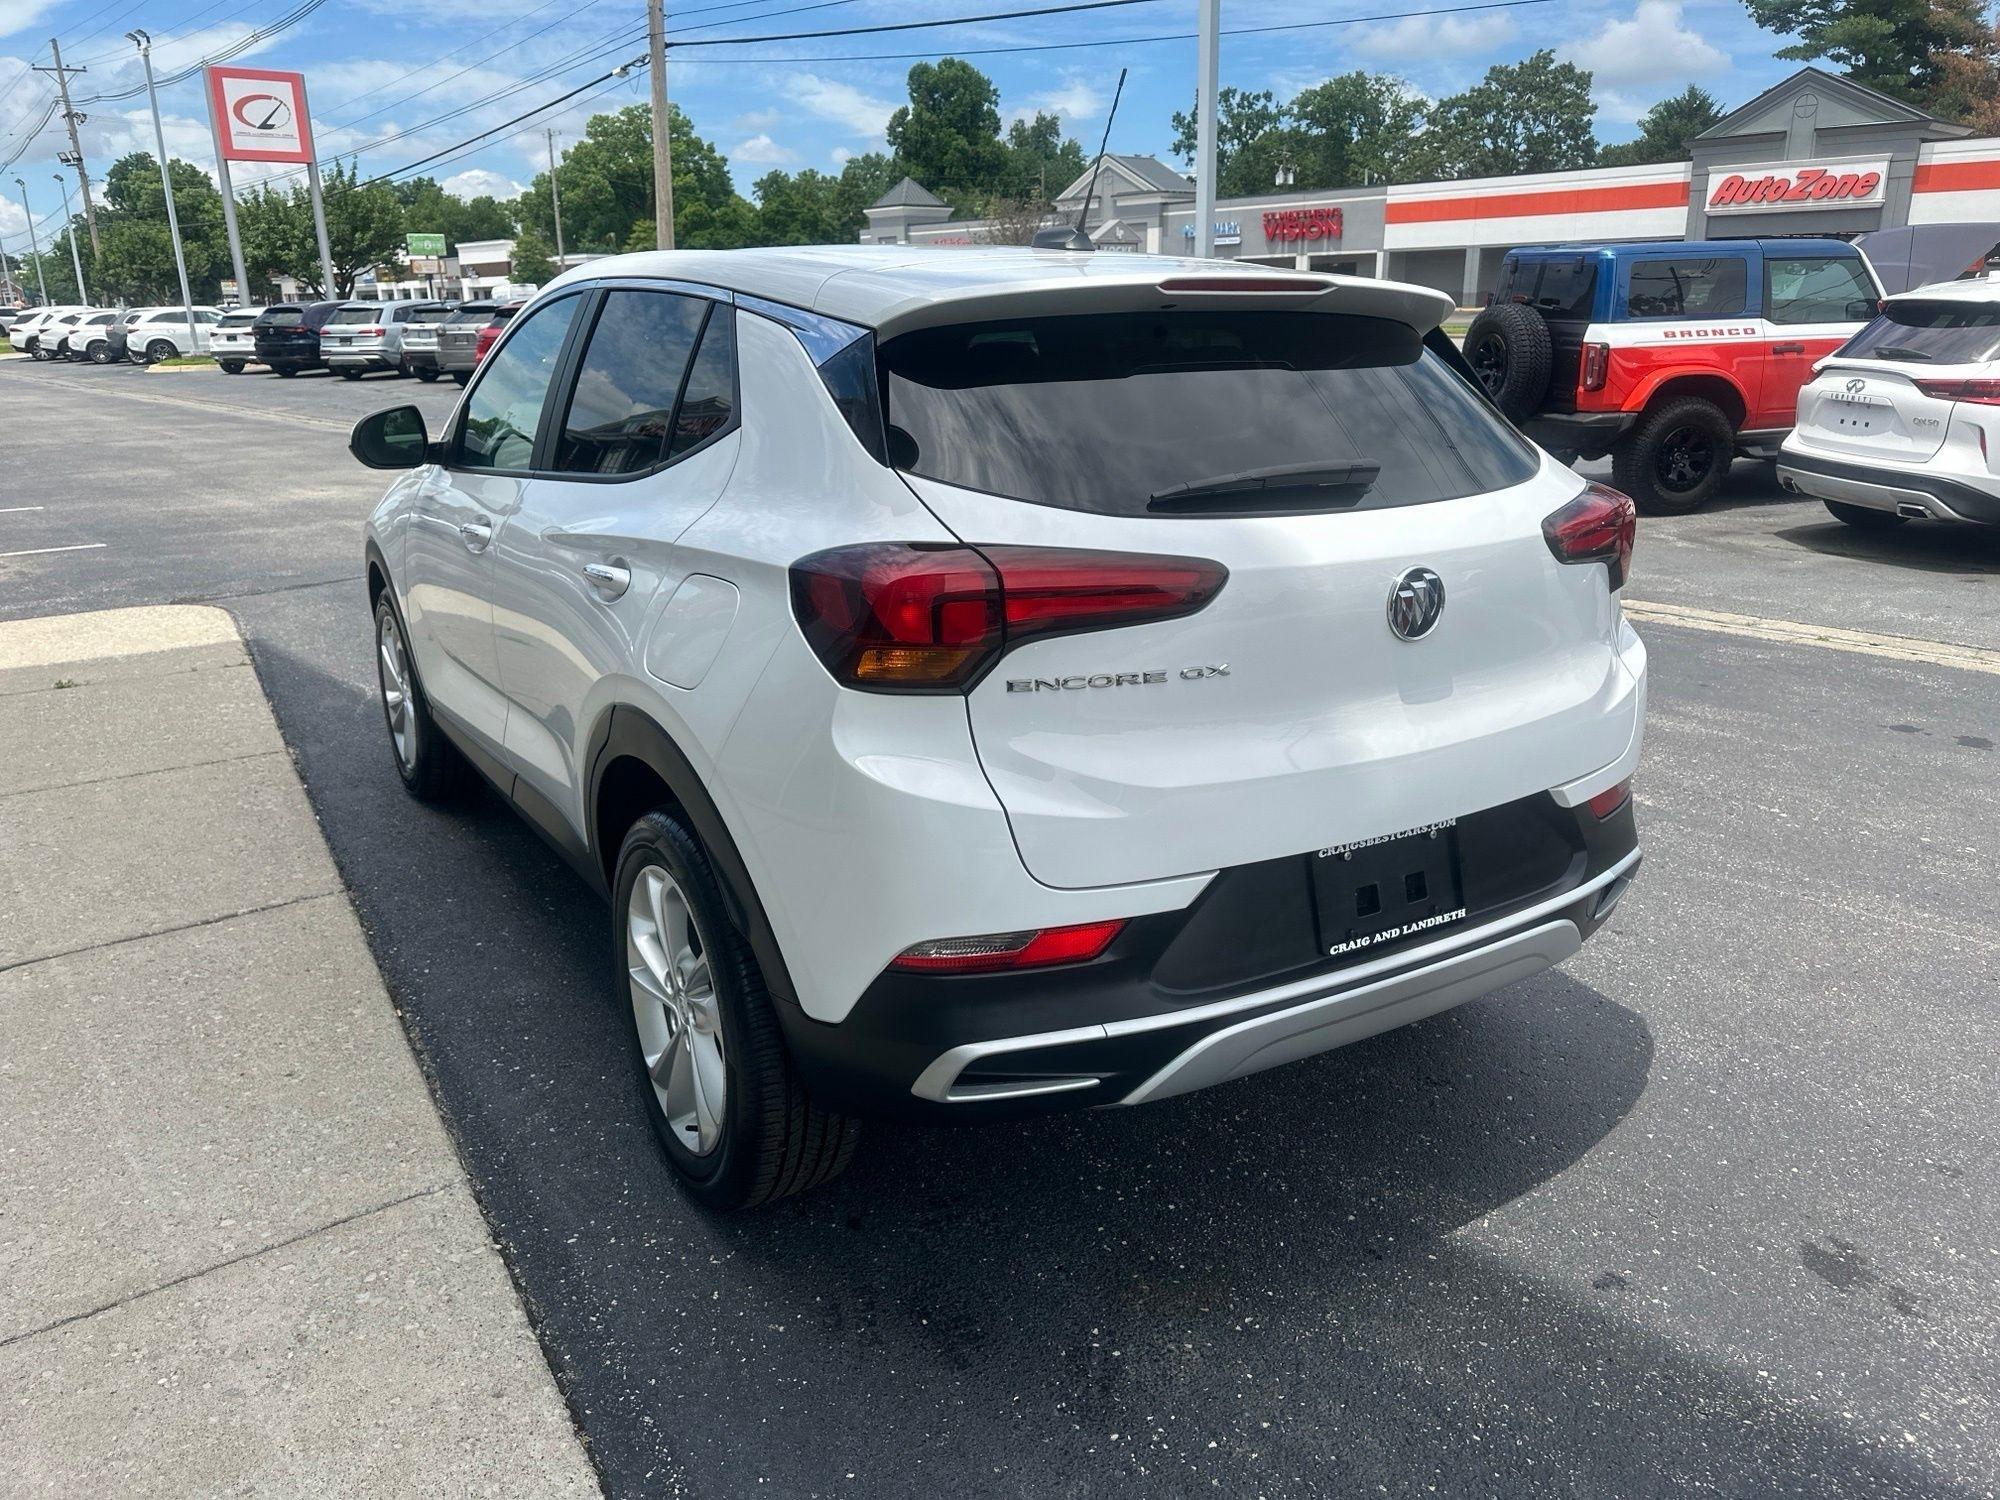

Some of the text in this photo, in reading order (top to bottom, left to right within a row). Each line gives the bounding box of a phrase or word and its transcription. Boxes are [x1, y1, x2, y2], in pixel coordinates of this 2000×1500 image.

[1709, 169, 1881, 206] AutoZone
[1263, 219, 1344, 242] VISION
[1663, 327, 1756, 339] BRONCO
[1006, 662, 1231, 693] ENCORE GX
[1317, 817, 1458, 858] CRAIGSBESTCARS.COM
[1329, 907, 1467, 956] CRAIG AND LANDRETH
